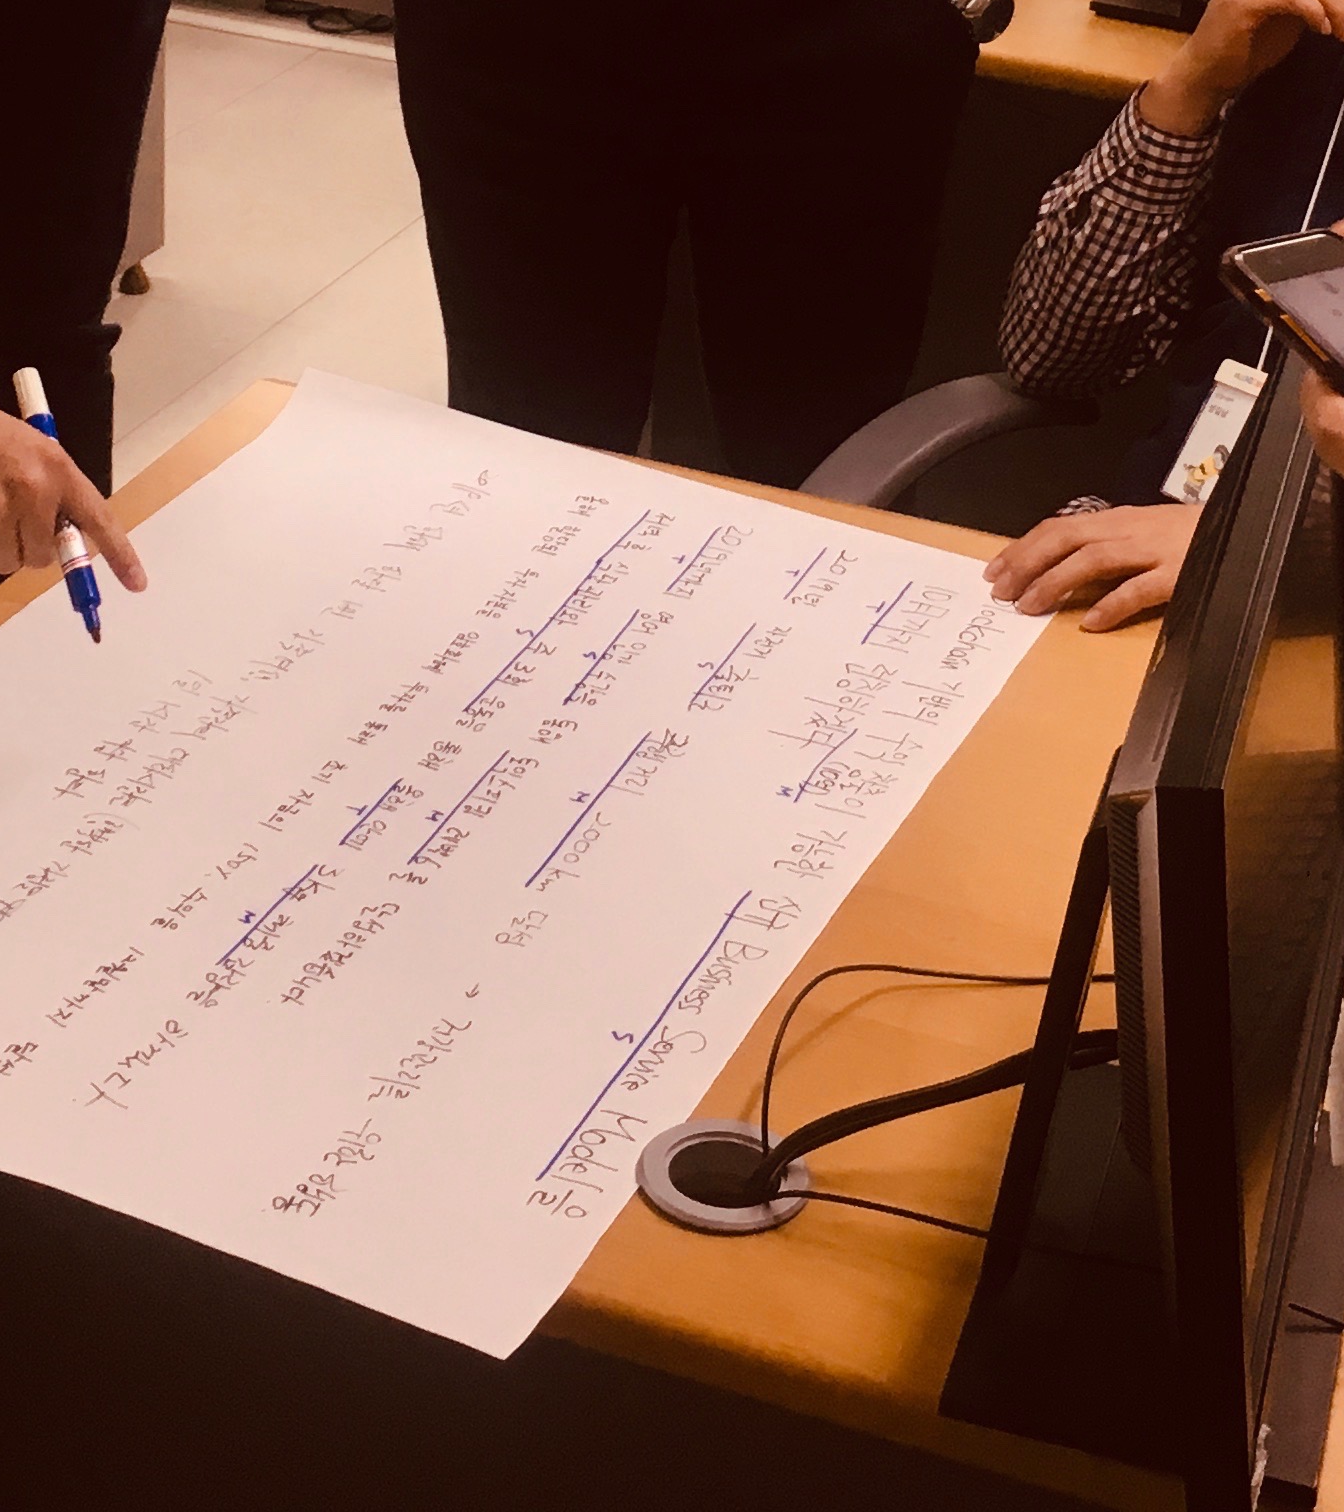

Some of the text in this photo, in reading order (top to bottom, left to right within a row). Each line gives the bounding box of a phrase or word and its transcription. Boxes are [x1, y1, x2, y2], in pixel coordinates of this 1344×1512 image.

[566, 494, 609, 517] 올해
[664, 524, 753, 600] 2019년까지
[671, 554, 686, 564] T
[784, 568, 800, 577] T
[790, 549, 858, 607] 2019년
[865, 600, 886, 614] T
[515, 627, 535, 640] S
[623, 610, 674, 635] 영어
[525, 636, 557, 656] 주
[742, 626, 792, 659] 자전거
[581, 650, 599, 662] S
[696, 661, 716, 670] S
[491, 657, 536, 687] 3회
[346, 720, 388, 746] 통해
[528, 718, 578, 744] 통해
[417, 740, 462, 771] 통해
[853, 732, 923, 766] 수익
[383, 783, 424, 812] 올해
[568, 790, 592, 804] M
[775, 784, 794, 797] M
[814, 768, 898, 819] 창출이
[345, 804, 369, 816] T
[424, 809, 444, 823] M
[346, 819, 387, 851] 안에
[773, 829, 847, 879] 가능한
[236, 909, 257, 925] M
[494, 909, 548, 947] 달성
[676, 939, 769, 1015] Business
[610, 1030, 634, 1044] S
[618, 1024, 707, 1091] Service
